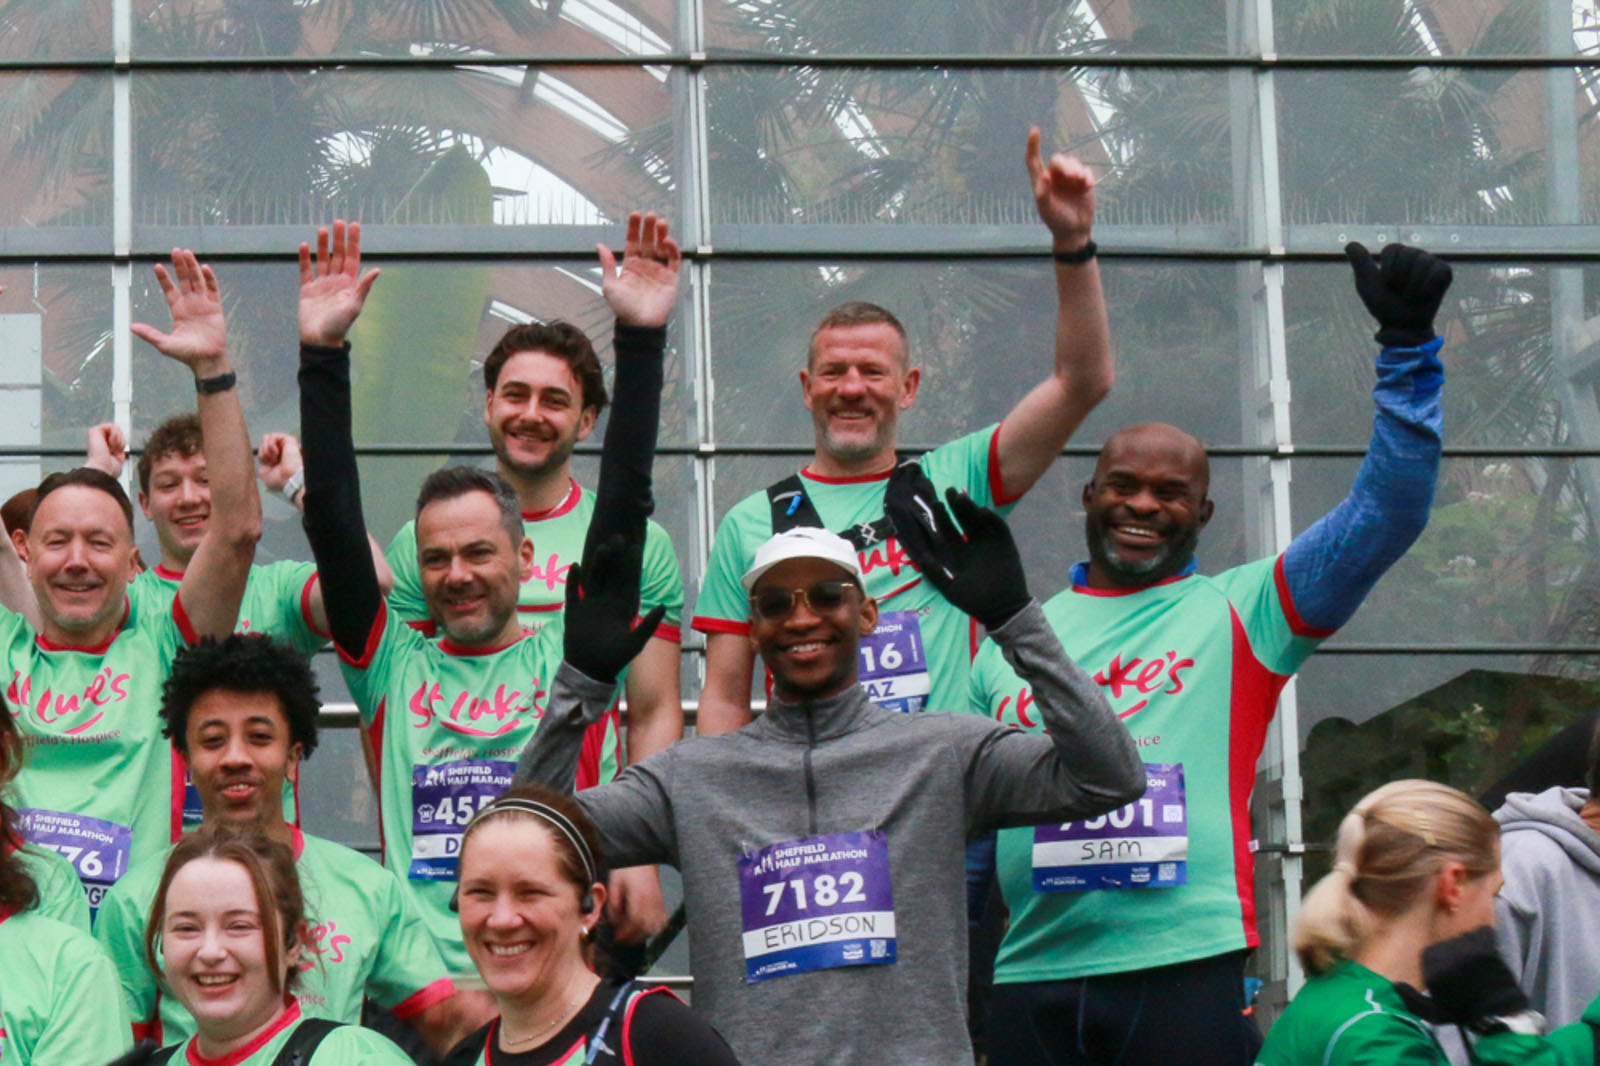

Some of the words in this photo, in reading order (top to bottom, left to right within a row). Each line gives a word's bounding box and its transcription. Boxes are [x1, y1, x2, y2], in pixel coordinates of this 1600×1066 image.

[861, 643, 903, 672] 16
[867, 681, 896, 698] AZ
[448, 766, 492, 777] SHEFFIELD
[471, 775, 512, 785] MARATH
[35, 814, 80, 827] SHEFFIELD
[33, 824, 56, 834] HALF
[58, 827, 114, 844] MARATHON
[775, 843, 826, 859] SHEFFIELD
[775, 857, 801, 869] HALF
[804, 849, 868, 866] MARATHON
[1081, 840, 1142, 860] SAM
[763, 871, 867, 916] 7182
[764, 915, 876, 949] ERIDSON
